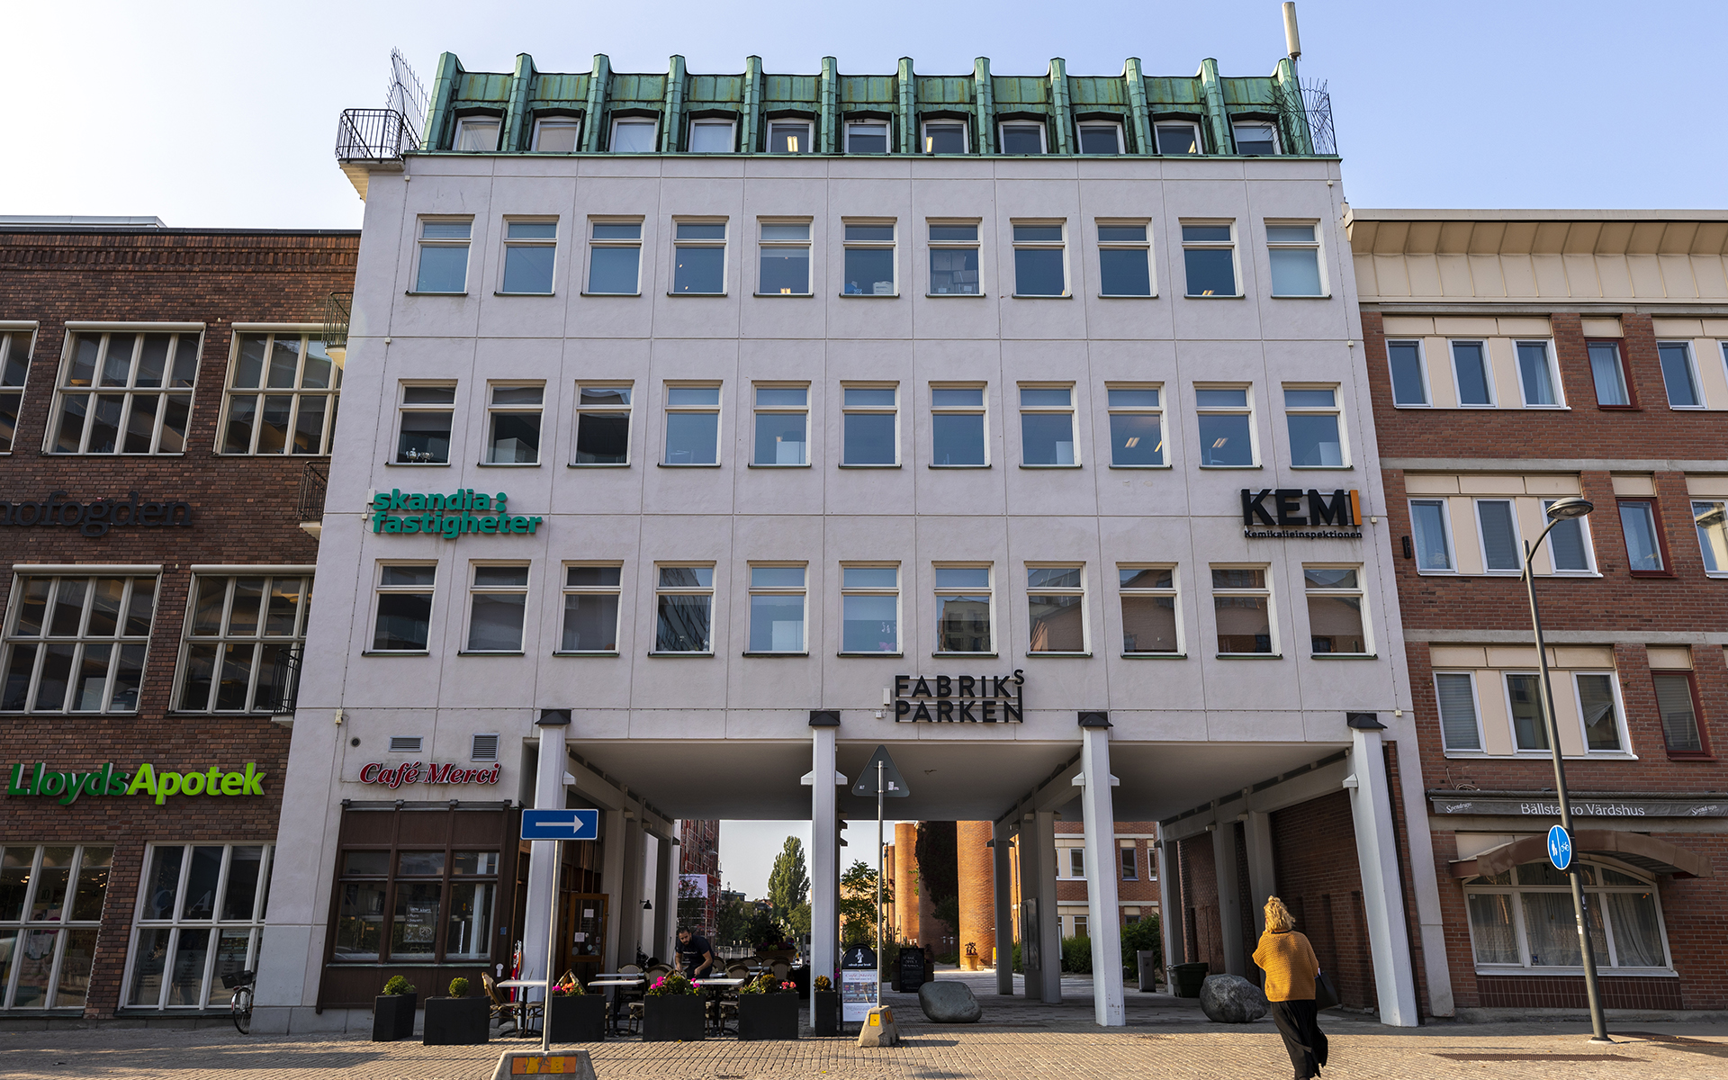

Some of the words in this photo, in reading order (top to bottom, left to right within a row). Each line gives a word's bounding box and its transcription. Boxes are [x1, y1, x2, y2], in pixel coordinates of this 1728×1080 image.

[1241, 489, 1362, 526] KEMI
[372, 511, 542, 539] fastigheter
[1244, 530, 1363, 540] Kemikalieinspektionen
[895, 686, 1024, 723] PARKEN
[7, 762, 266, 805] LloydsApotek
[359, 760, 421, 789] Café
[423, 762, 501, 785] Merci
[1521, 803, 1584, 816] Bällstaro
[1585, 803, 1645, 816] Värdshus
